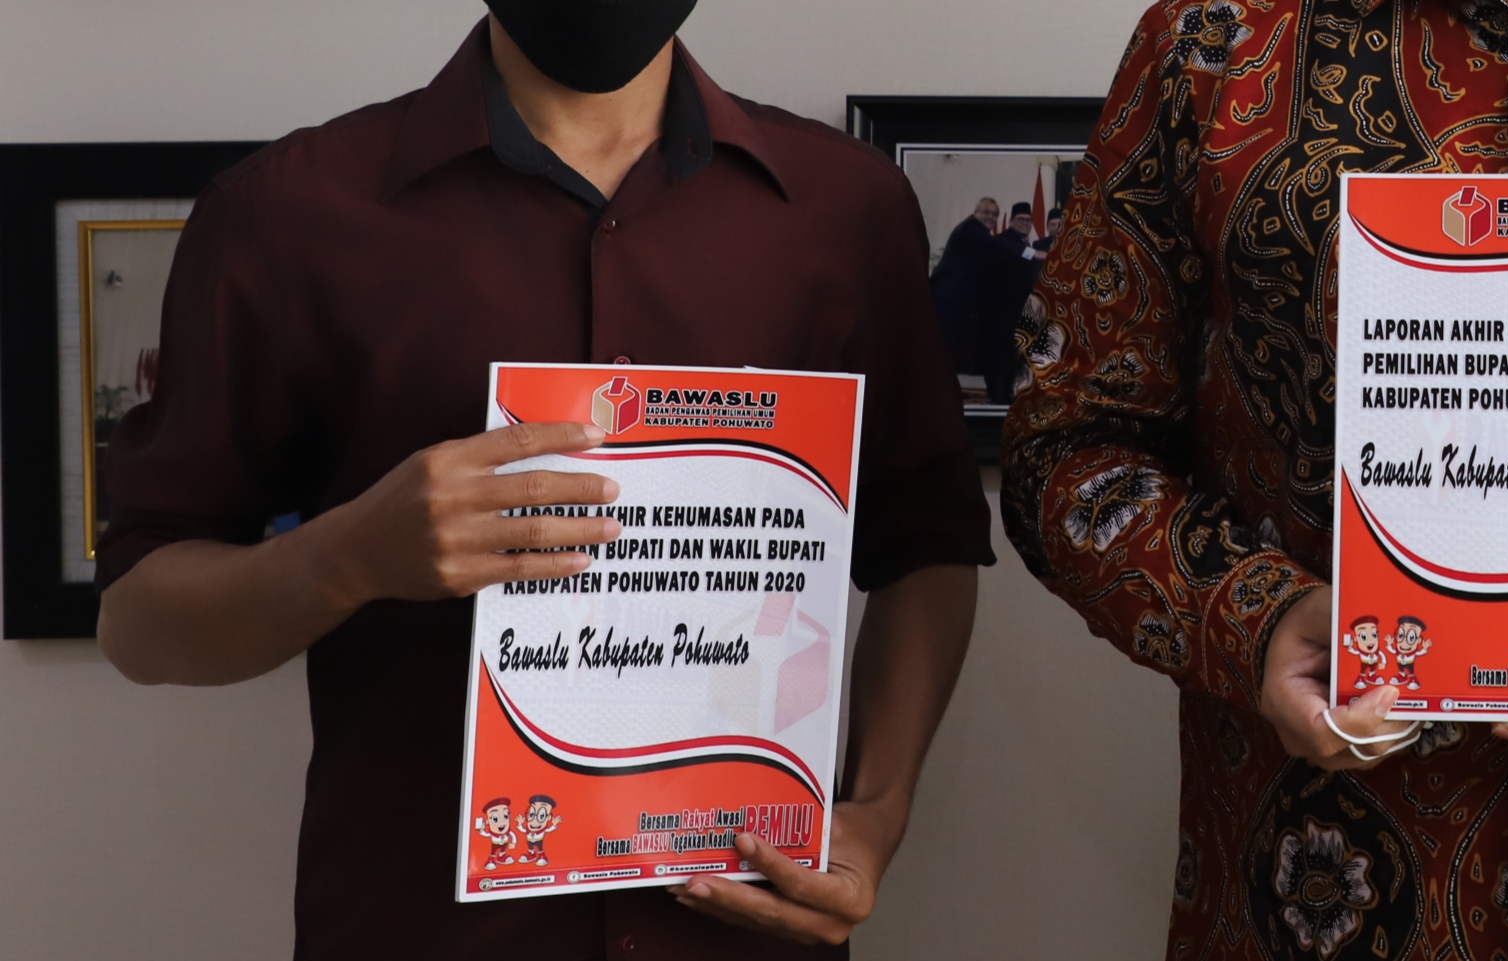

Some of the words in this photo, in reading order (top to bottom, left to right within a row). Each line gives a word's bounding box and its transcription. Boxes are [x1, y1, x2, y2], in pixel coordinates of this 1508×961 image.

[1363, 319, 1444, 340] LAPORAN
[1450, 320, 1505, 342] AKHIR
[1363, 353, 1458, 375] PEMILIHAN
[646, 387, 777, 408] BAWASLU
[1362, 387, 1462, 409] KABUPATEN
[644, 417, 709, 427] KABUPATEN
[712, 418, 774, 429] POHUWATO
[645, 406, 670, 415] BADAN
[671, 407, 710, 416] PENGAWAS
[711, 408, 752, 417] PEMILIHAN
[753, 409, 775, 418] UMUM
[1360, 442, 1432, 488] Bawaslu
[595, 506, 646, 526] AKHIR
[652, 506, 756, 527] KEHUMASAN
[761, 508, 805, 529] PADA
[605, 539, 664, 559] BUPATI
[669, 539, 704, 559] DAN
[709, 539, 762, 559] WAKIL
[767, 540, 826, 561] BUPATI
[503, 572, 602, 595] KABUPATEN
[608, 571, 700, 593] POHUWATO
[705, 571, 759, 592] TAHUN
[764, 571, 806, 592] 2020
[499, 627, 569, 672] Bawaslu
[578, 625, 664, 679] Kabupaten
[671, 623, 749, 668] Pohuwato
[1470, 665, 1507, 686] Bersama
[639, 810, 680, 832] Bersama
[681, 808, 715, 831] Rakyat
[744, 803, 815, 847] PEMILU
[596, 836, 632, 856] Bersama
[631, 831, 670, 854] BAWASLU
[670, 830, 707, 856] Tegakkan
[707, 829, 737, 850] Keadil
